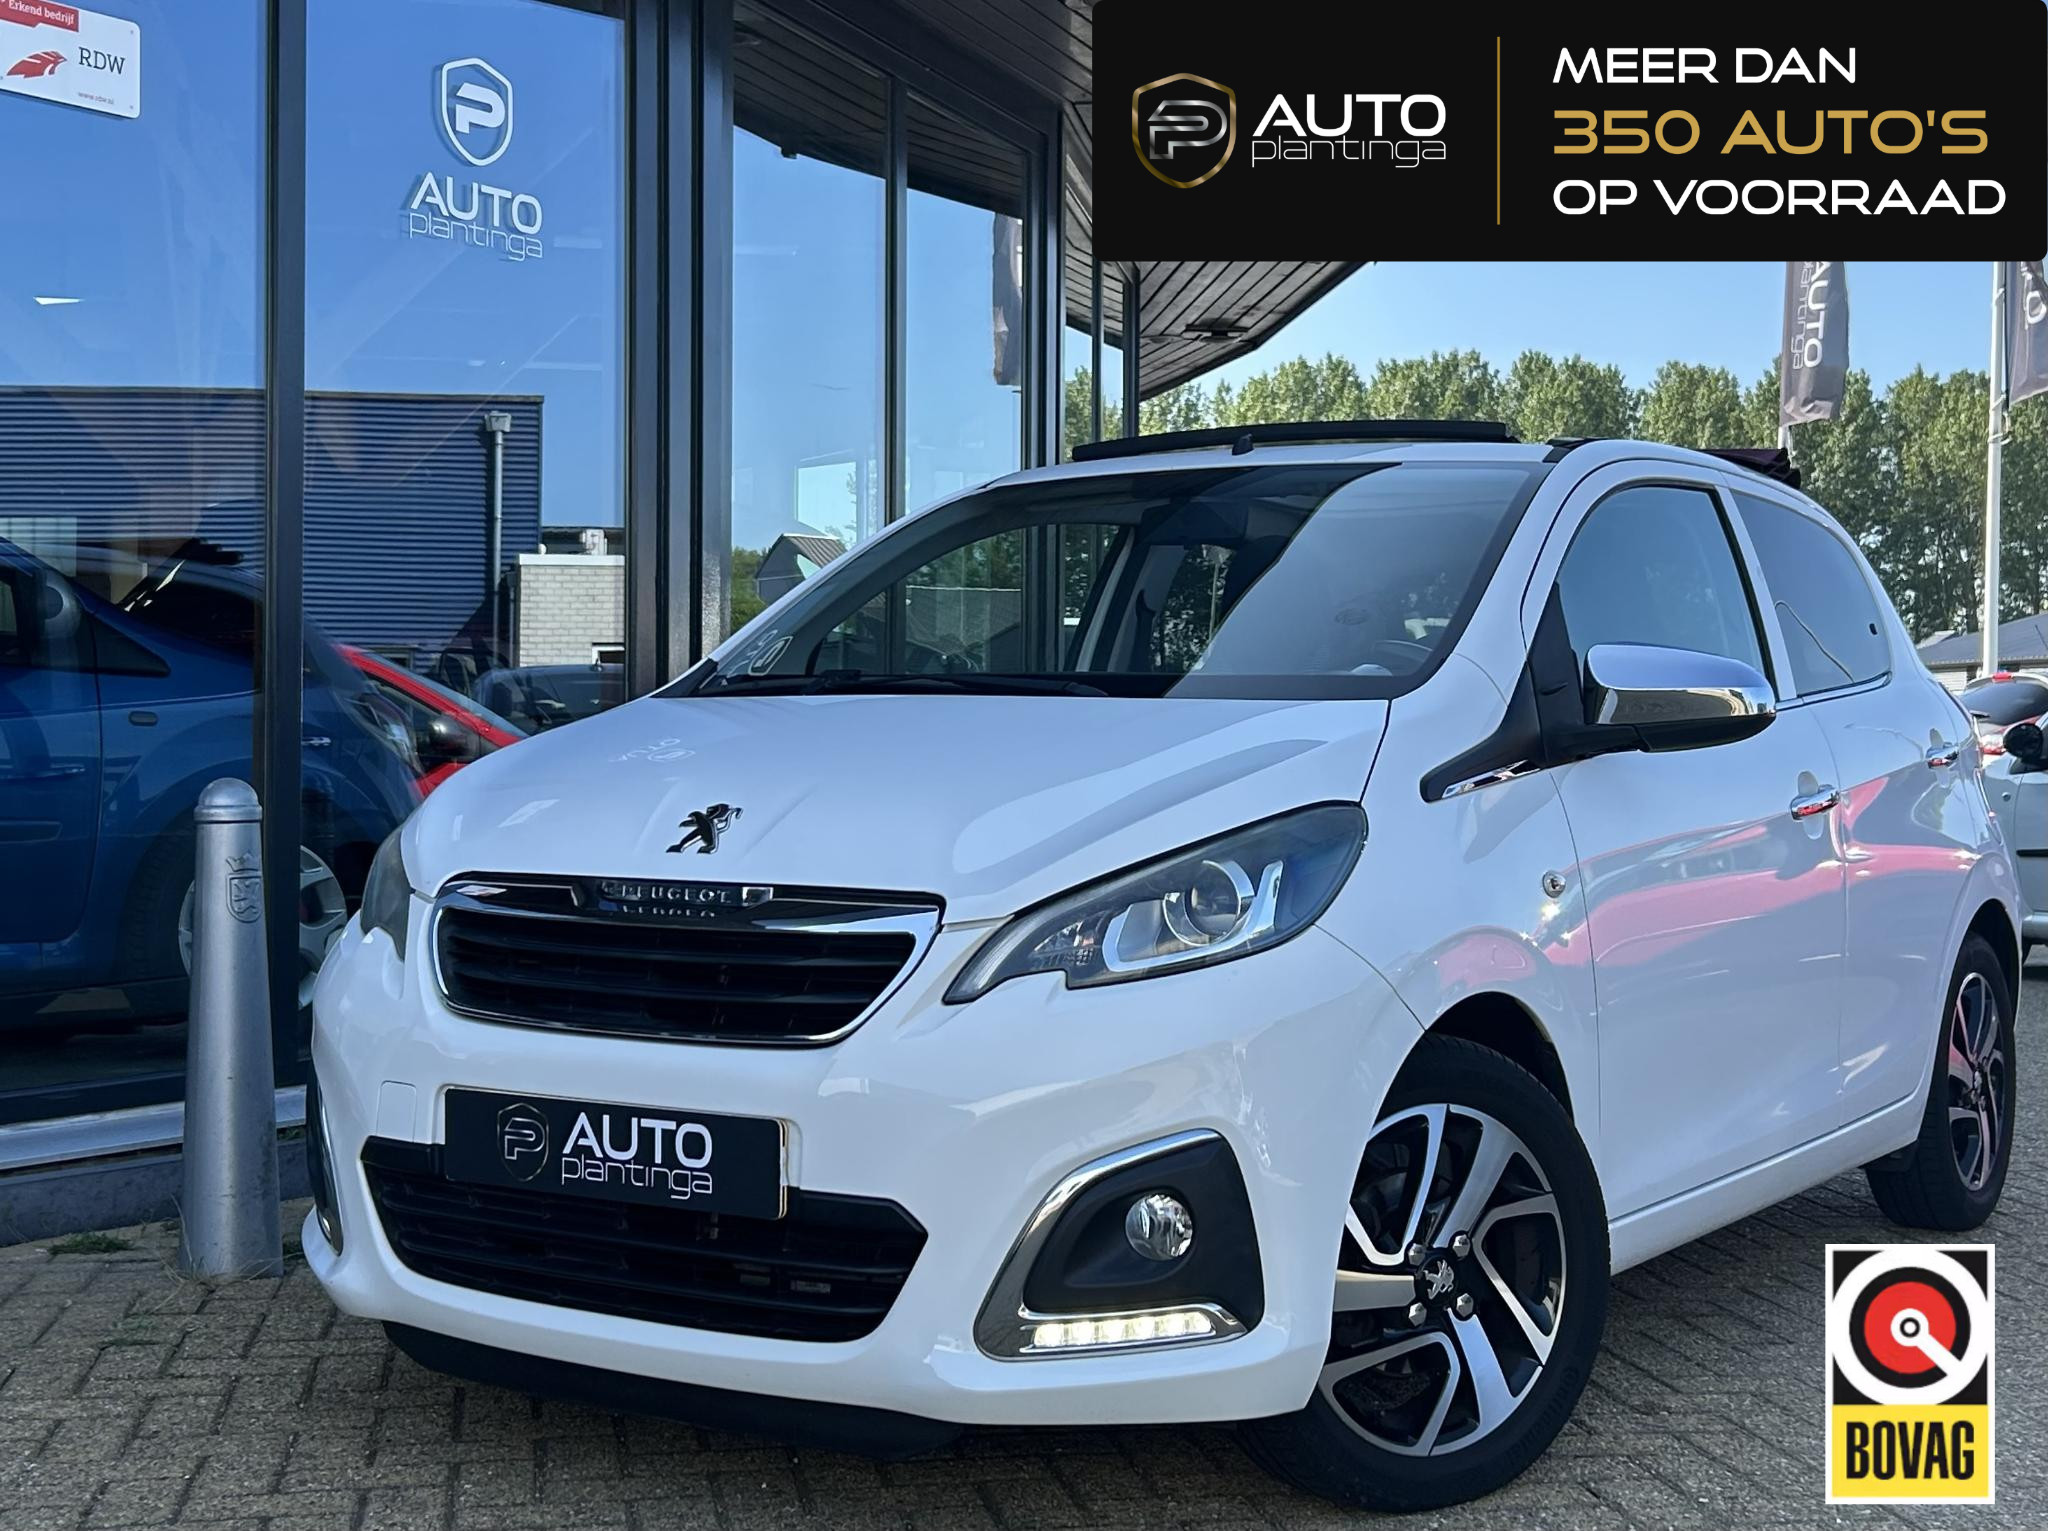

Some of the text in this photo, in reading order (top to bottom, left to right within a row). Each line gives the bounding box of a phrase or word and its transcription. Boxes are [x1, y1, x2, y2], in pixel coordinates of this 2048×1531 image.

[9, 0, 75, 25] Erkend bedrijf
[78, 46, 126, 75] RDW
[410, 171, 543, 235] AUTO
[409, 211, 543, 261] plantinga
[562, 1111, 713, 1169] AUTO
[561, 1153, 713, 1201] plantinga
